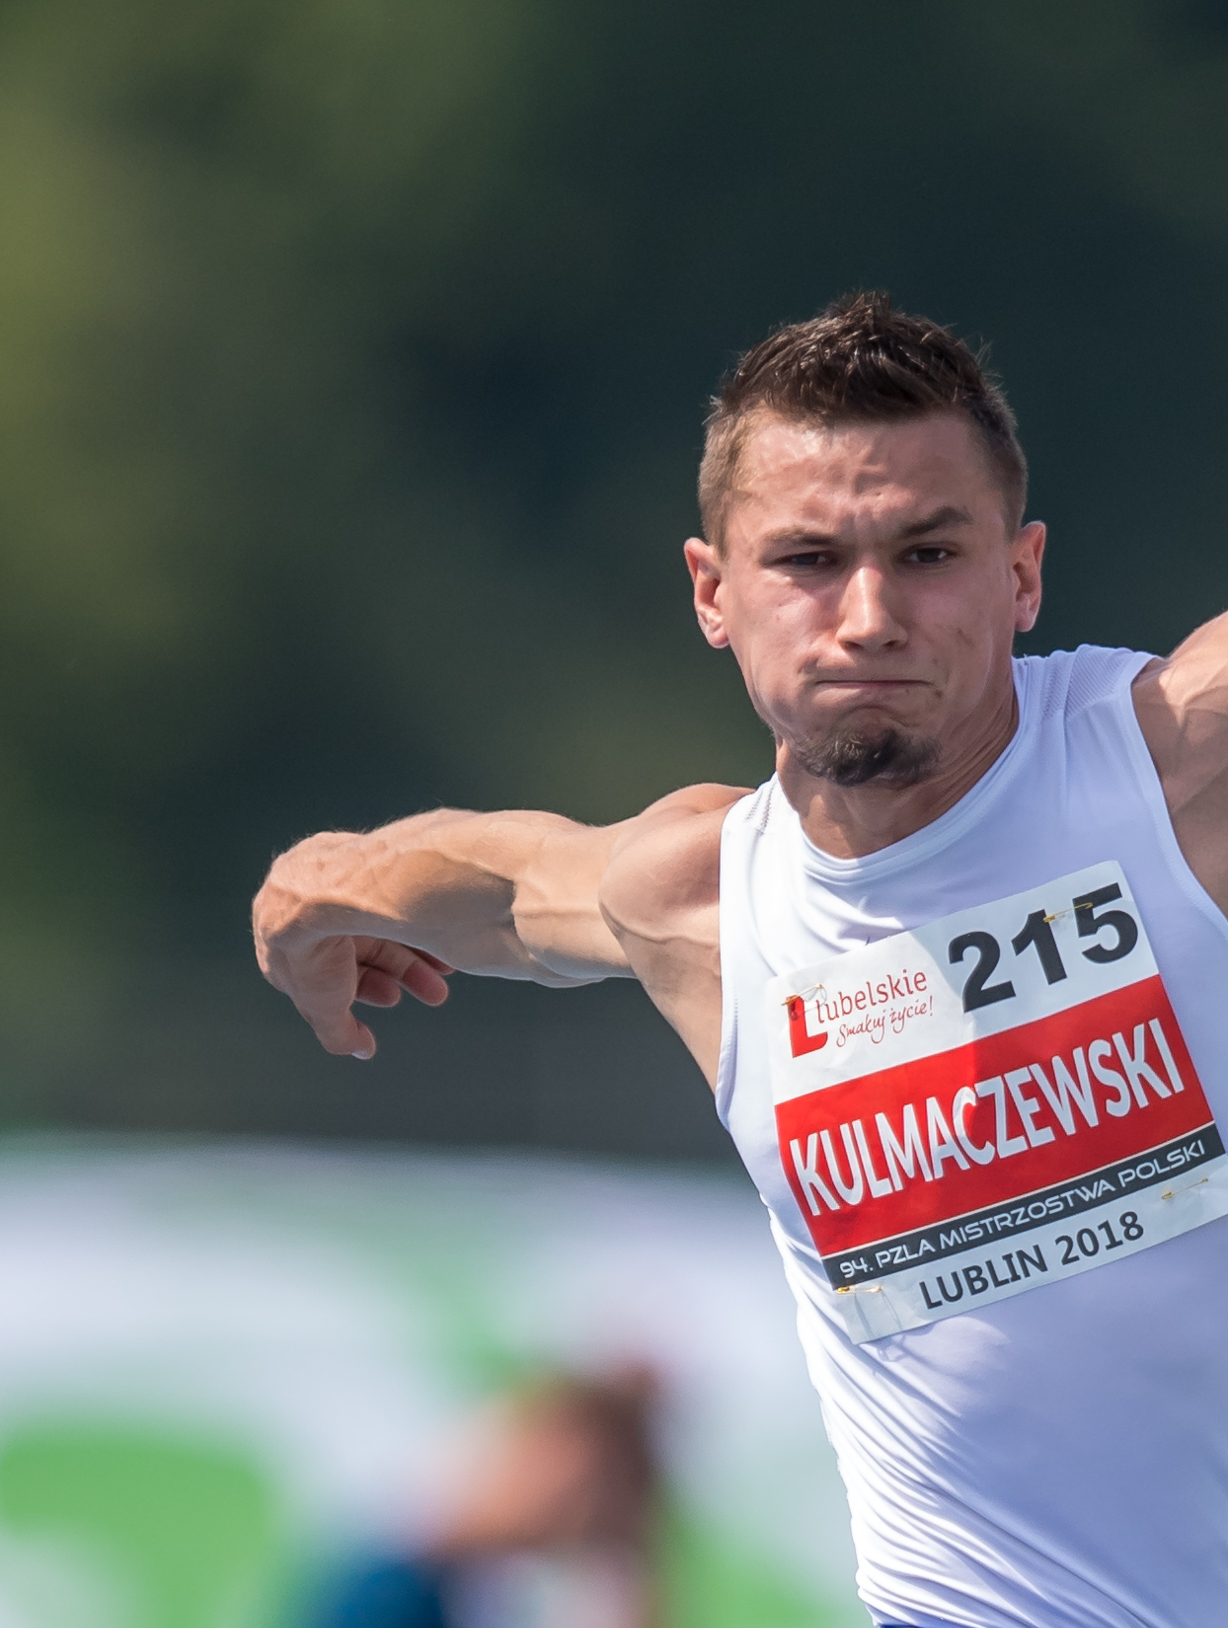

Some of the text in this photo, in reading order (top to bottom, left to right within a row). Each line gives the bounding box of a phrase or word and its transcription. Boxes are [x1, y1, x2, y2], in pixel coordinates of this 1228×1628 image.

[948, 881, 1139, 1013] 215
[836, 995, 934, 1048] Smakuj życie!
[789, 1018, 1185, 1217] KULMACZEWSKI
[839, 1139, 1206, 1279] 94. PZLA MISTRZOSTWA POLSKI
[918, 1211, 1145, 1311] LUBLIN 2018
